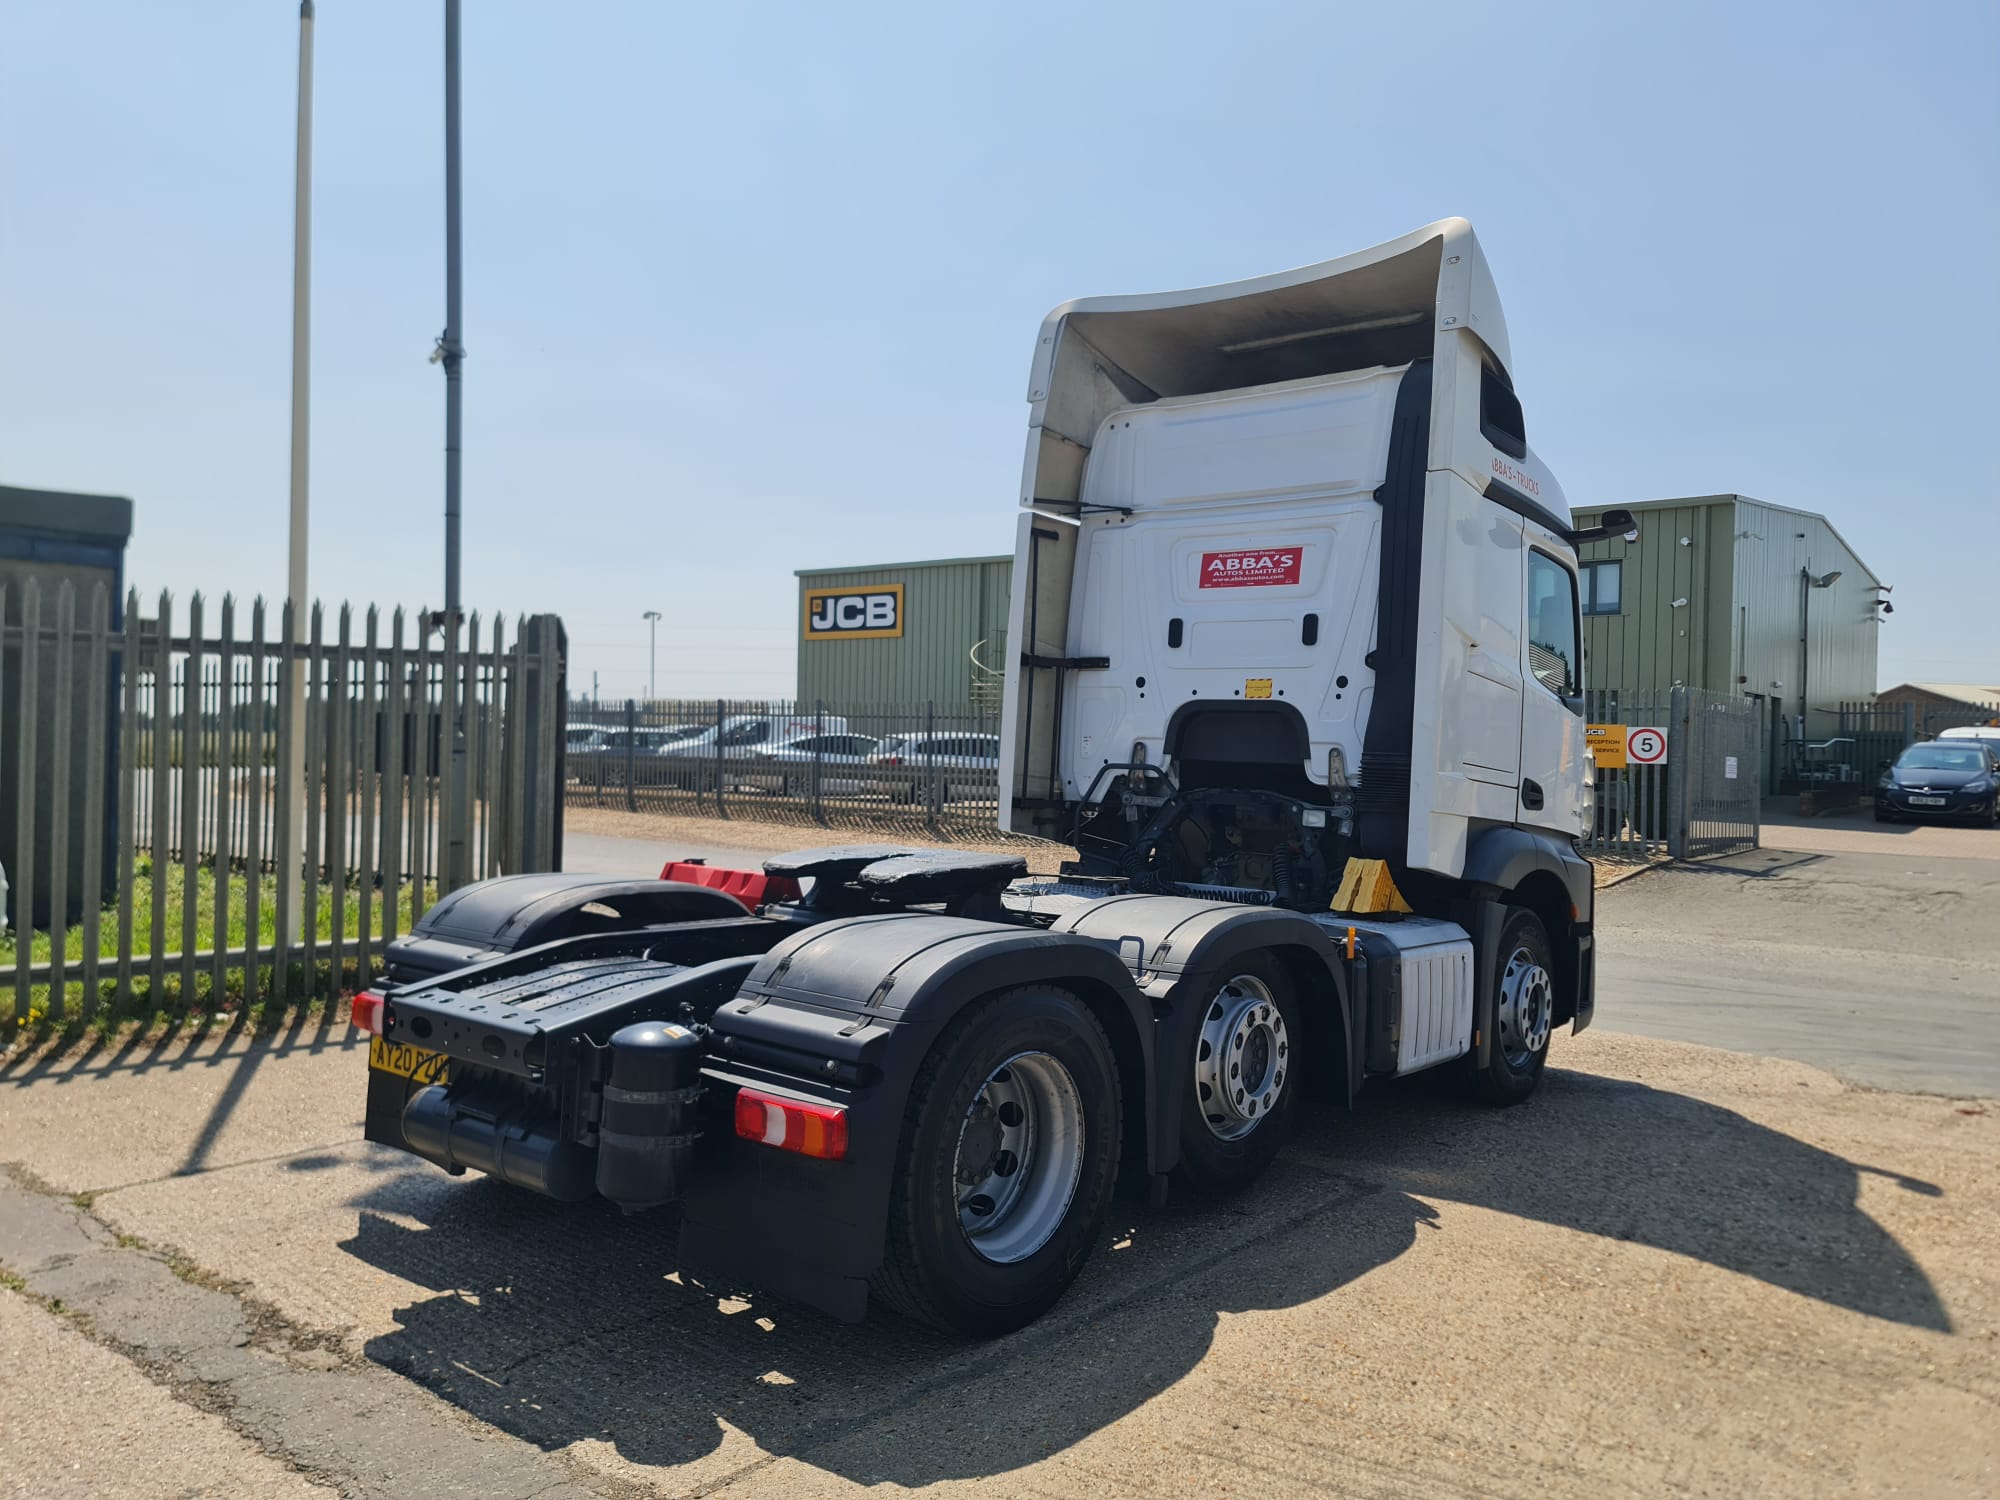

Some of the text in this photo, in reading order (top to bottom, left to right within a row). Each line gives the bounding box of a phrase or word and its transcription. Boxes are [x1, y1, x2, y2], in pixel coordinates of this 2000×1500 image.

[1208, 555, 1294, 571] ABBA'S
[812, 595, 895, 630] JCB
[1641, 738, 1653, 752] 5
[377, 1041, 412, 1071] AY20
